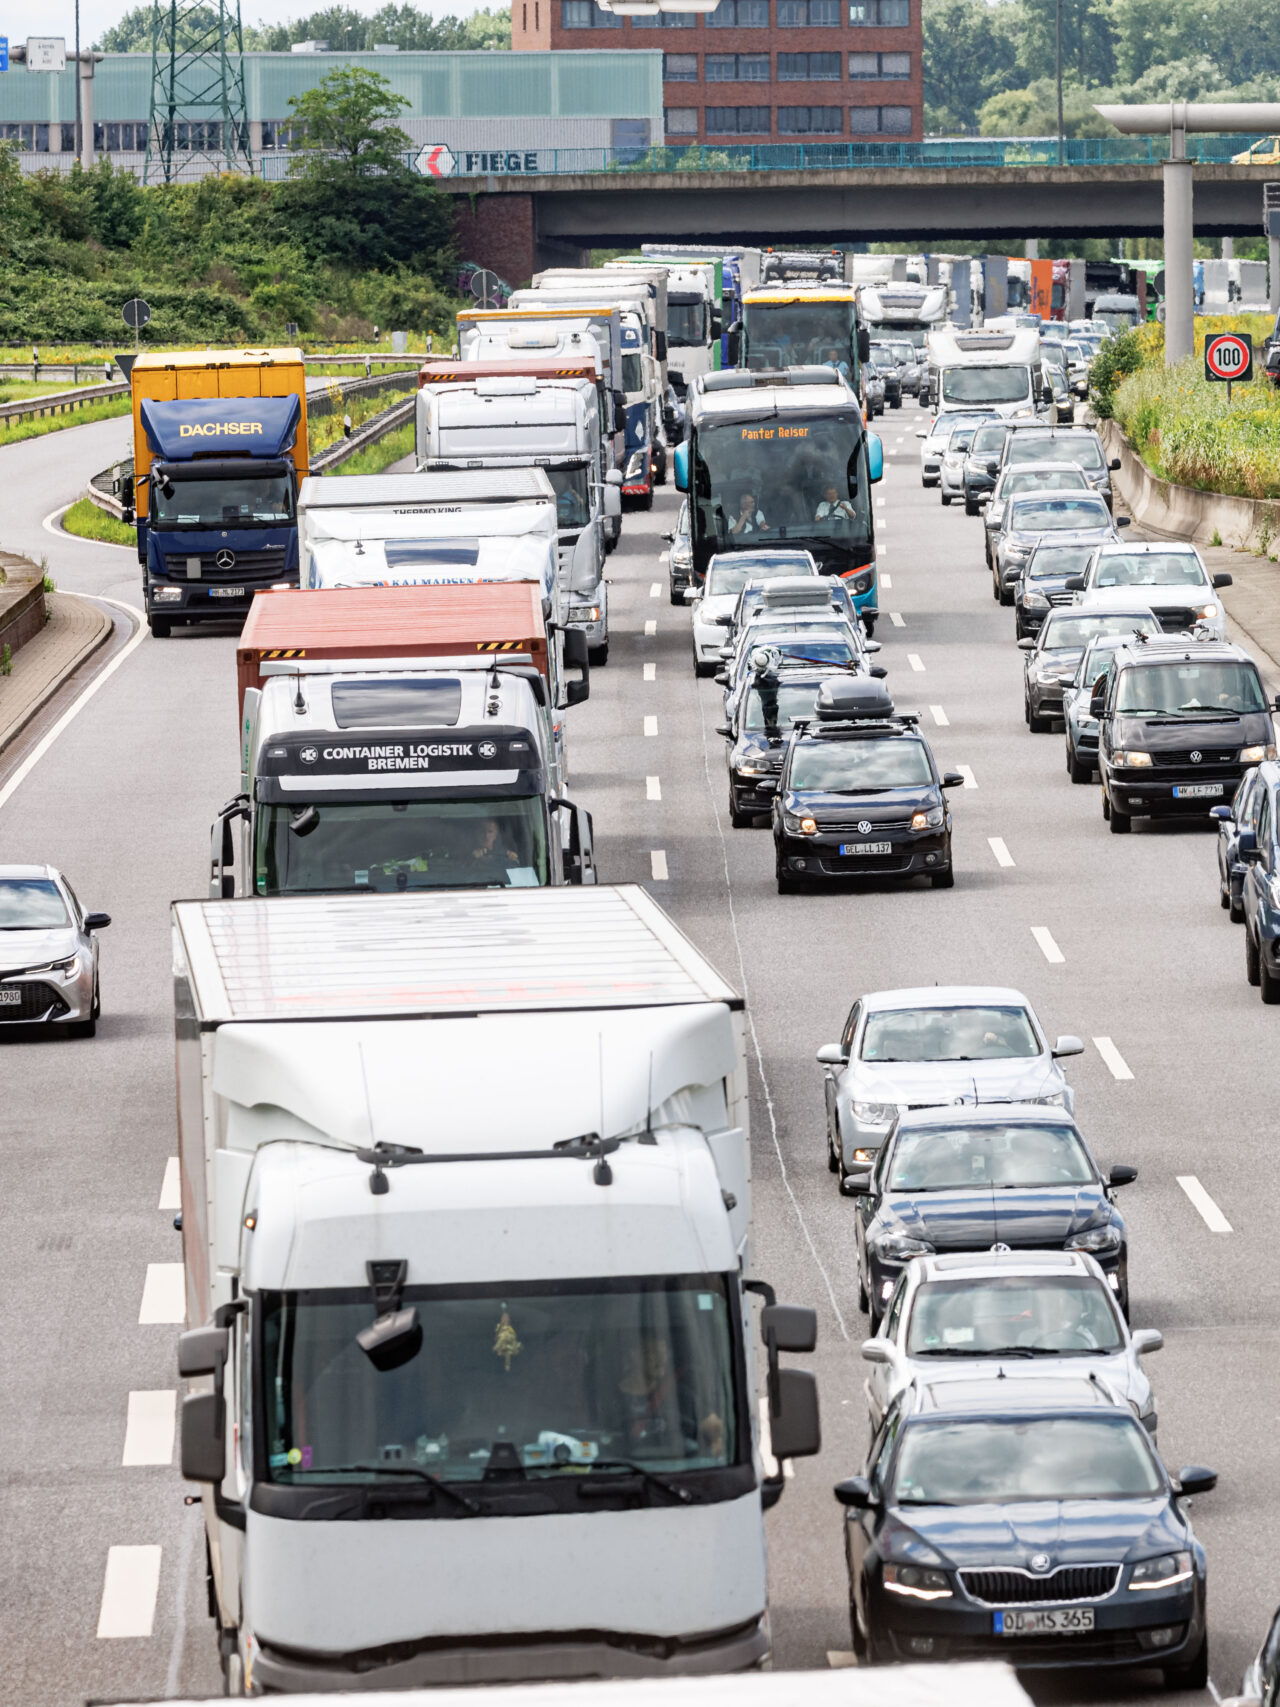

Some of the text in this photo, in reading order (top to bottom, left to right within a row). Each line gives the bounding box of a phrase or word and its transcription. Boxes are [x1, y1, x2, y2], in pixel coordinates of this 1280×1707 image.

[466, 153, 538, 171] FIEGE
[1216, 347, 1241, 367] 100
[179, 422, 263, 437] DACHSER
[323, 744, 473, 759] CONTAINER LOGISTIK
[368, 757, 429, 770] BREMEN
[875, 843, 890, 853] 137
[1004, 1611, 1093, 1630] OD MS 365
